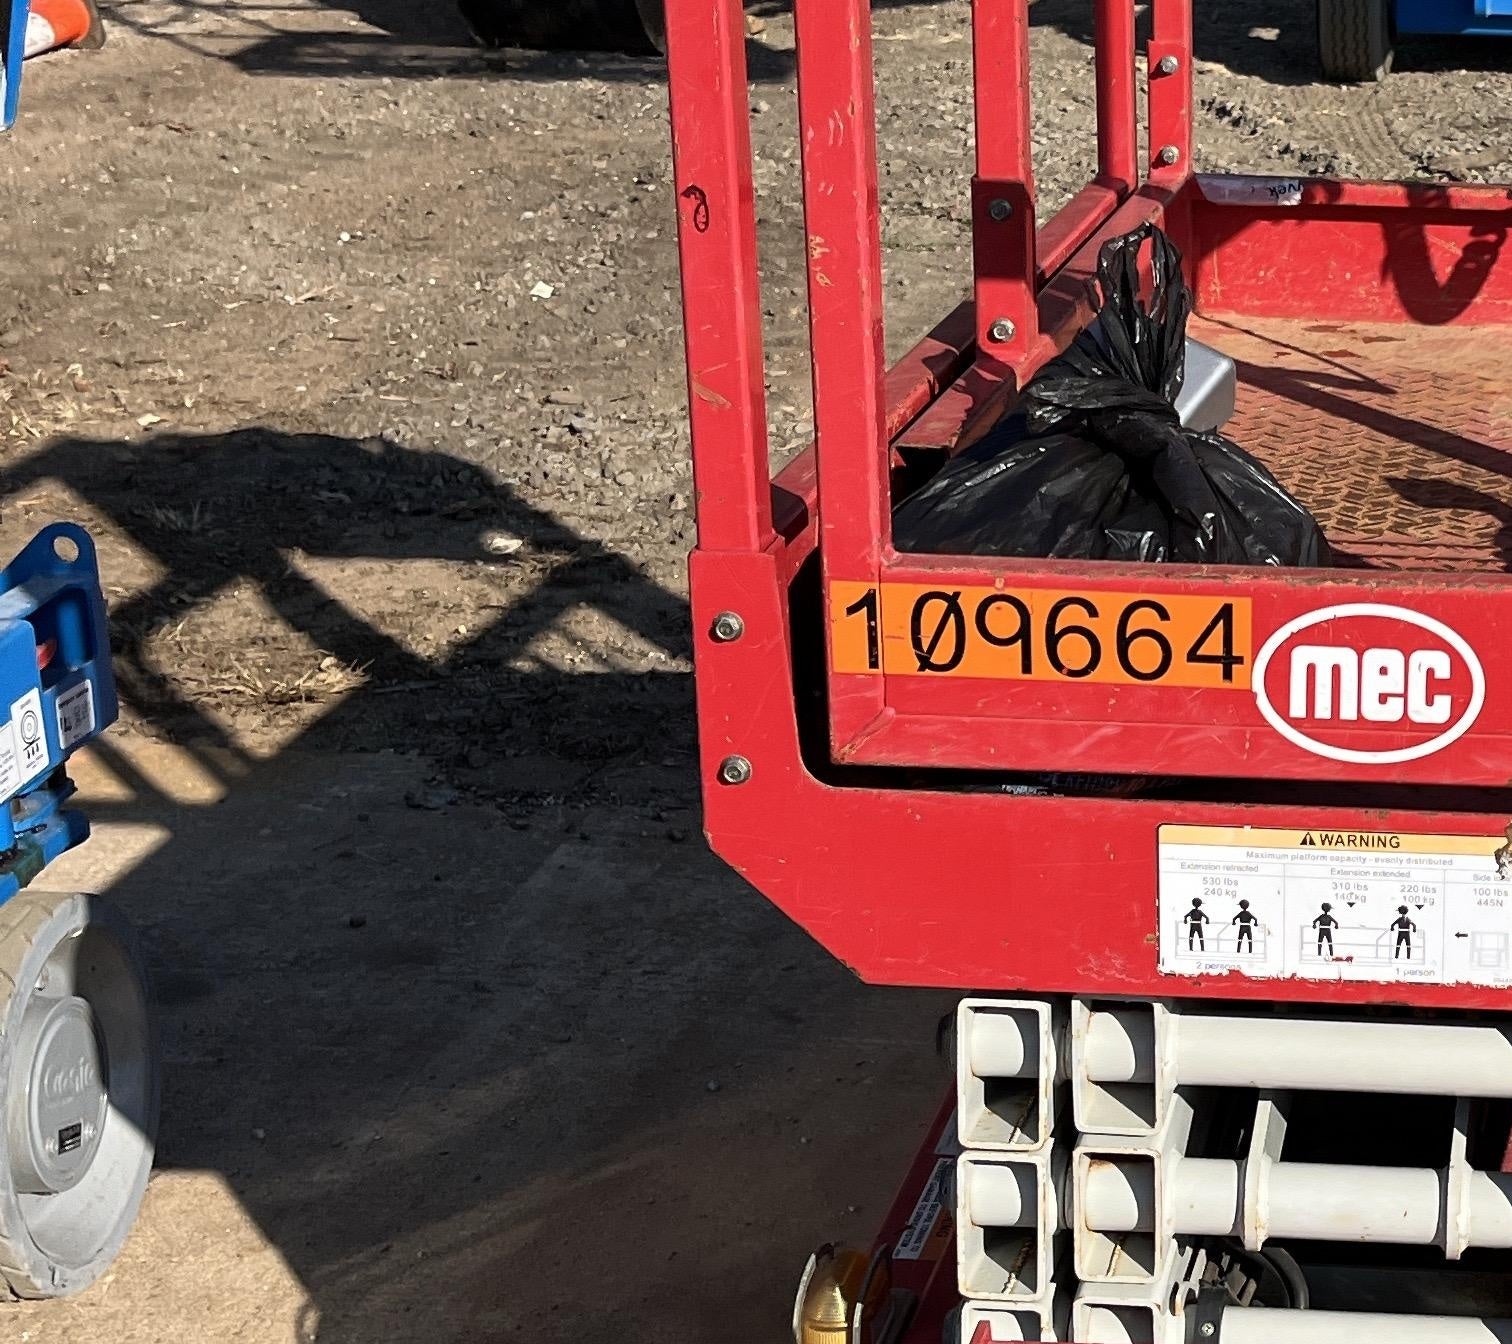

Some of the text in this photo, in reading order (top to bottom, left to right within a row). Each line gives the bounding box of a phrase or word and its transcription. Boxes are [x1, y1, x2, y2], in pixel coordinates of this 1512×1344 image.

[844, 587, 1246, 685] 109664
[1319, 832, 1401, 849] WARNING
[1245, 850, 1289, 861] Maximum
[1290, 853, 1328, 863] platform
[1329, 855, 1367, 865] capacity
[1374, 857, 1404, 866] evenly
[1405, 856, 1453, 866] distributed
[1180, 861, 1259, 873] Extension retracted
[1329, 867, 1411, 879] Extension extended
[1472, 873, 1492, 882] Side
[1202, 876, 1239, 887] 530 lbs
[1331, 881, 1369, 892] 310 lbs
[1203, 887, 1238, 899] 240 kg
[1399, 884, 1437, 894] 220 lbs
[1472, 887, 1509, 898] 100 lbs
[1334, 892, 1367, 904] 140 kg
[1402, 895, 1435, 906] 100 kg
[1476, 898, 1504, 908] 445N
[1195, 961, 1202, 970] 2
[1402, 968, 1436, 978] person
